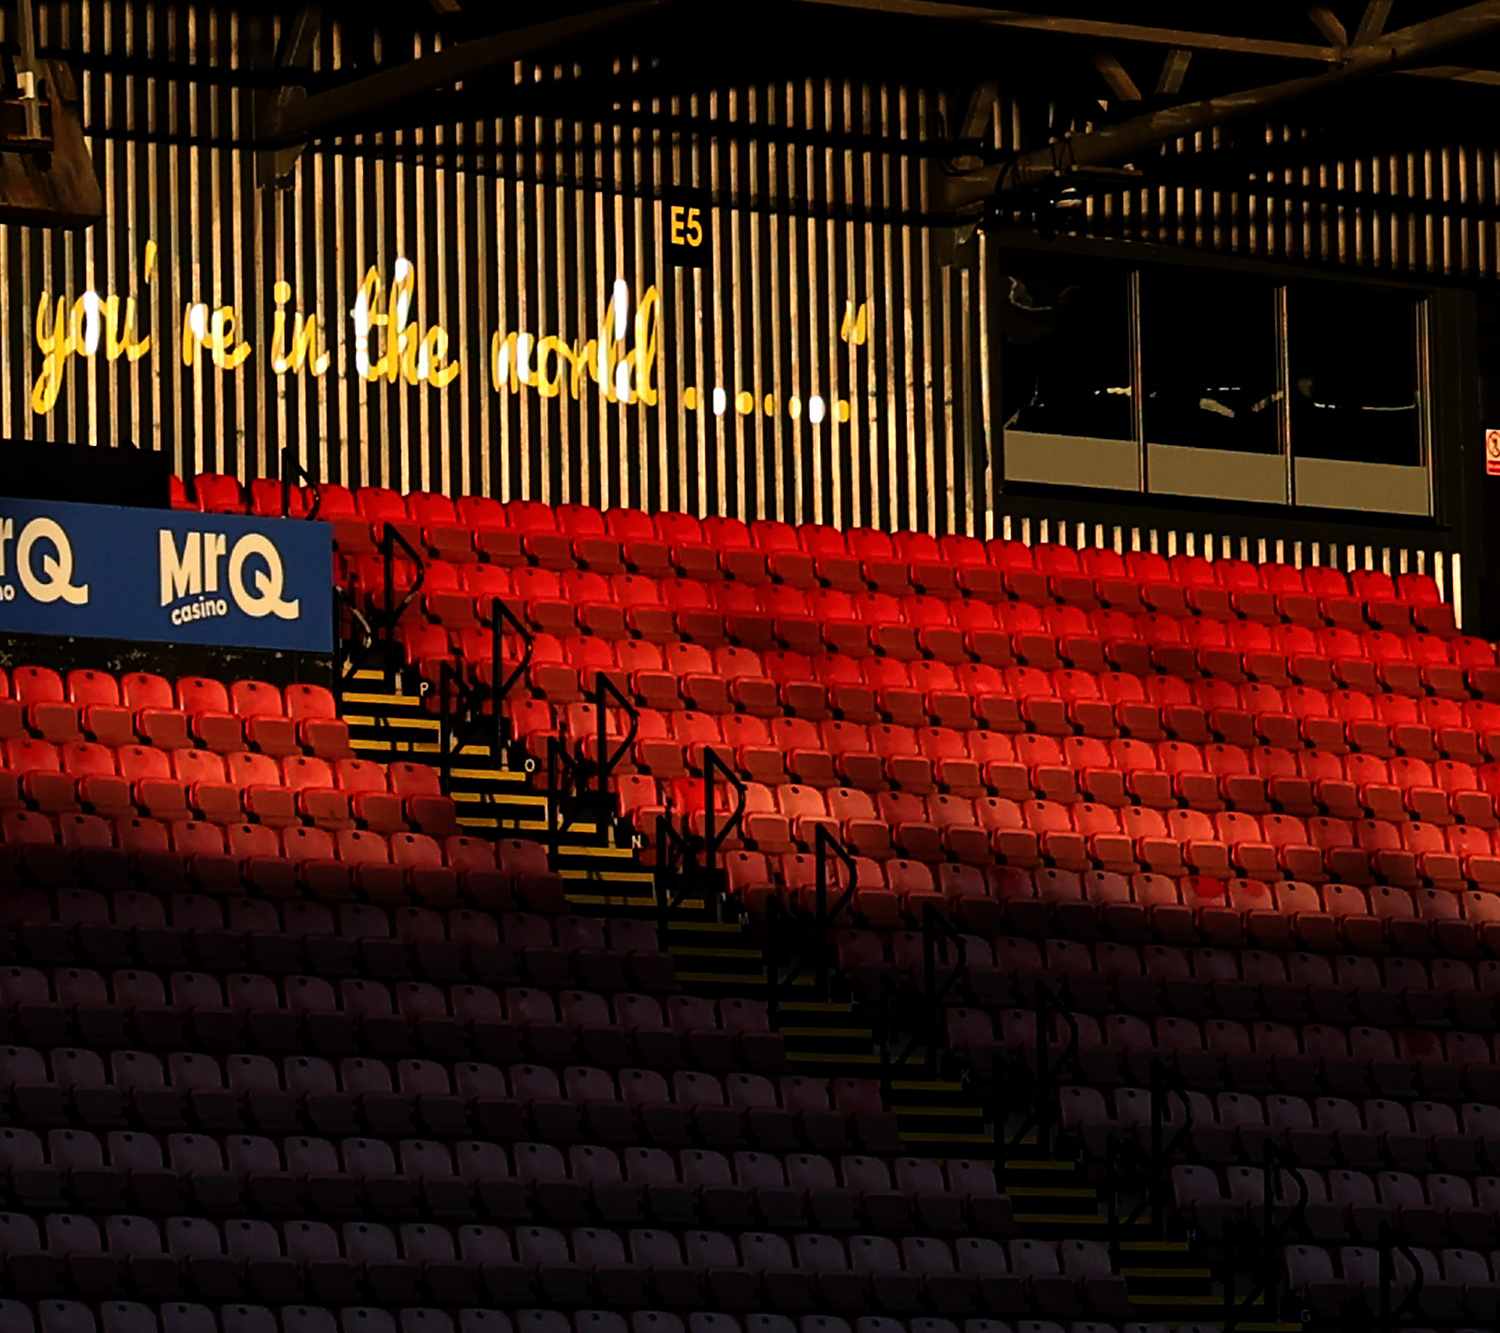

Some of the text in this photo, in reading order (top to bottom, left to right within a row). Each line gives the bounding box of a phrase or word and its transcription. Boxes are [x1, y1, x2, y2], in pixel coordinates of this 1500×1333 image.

[670, 205, 703, 247] E5
[271, 280, 331, 377] in
[352, 257, 460, 388] the
[159, 529, 300, 620] MrQ
[170, 594, 228, 626] casino
[420, 681, 429, 696] P
[632, 834, 642, 849] N
[961, 1069, 970, 1083] K
